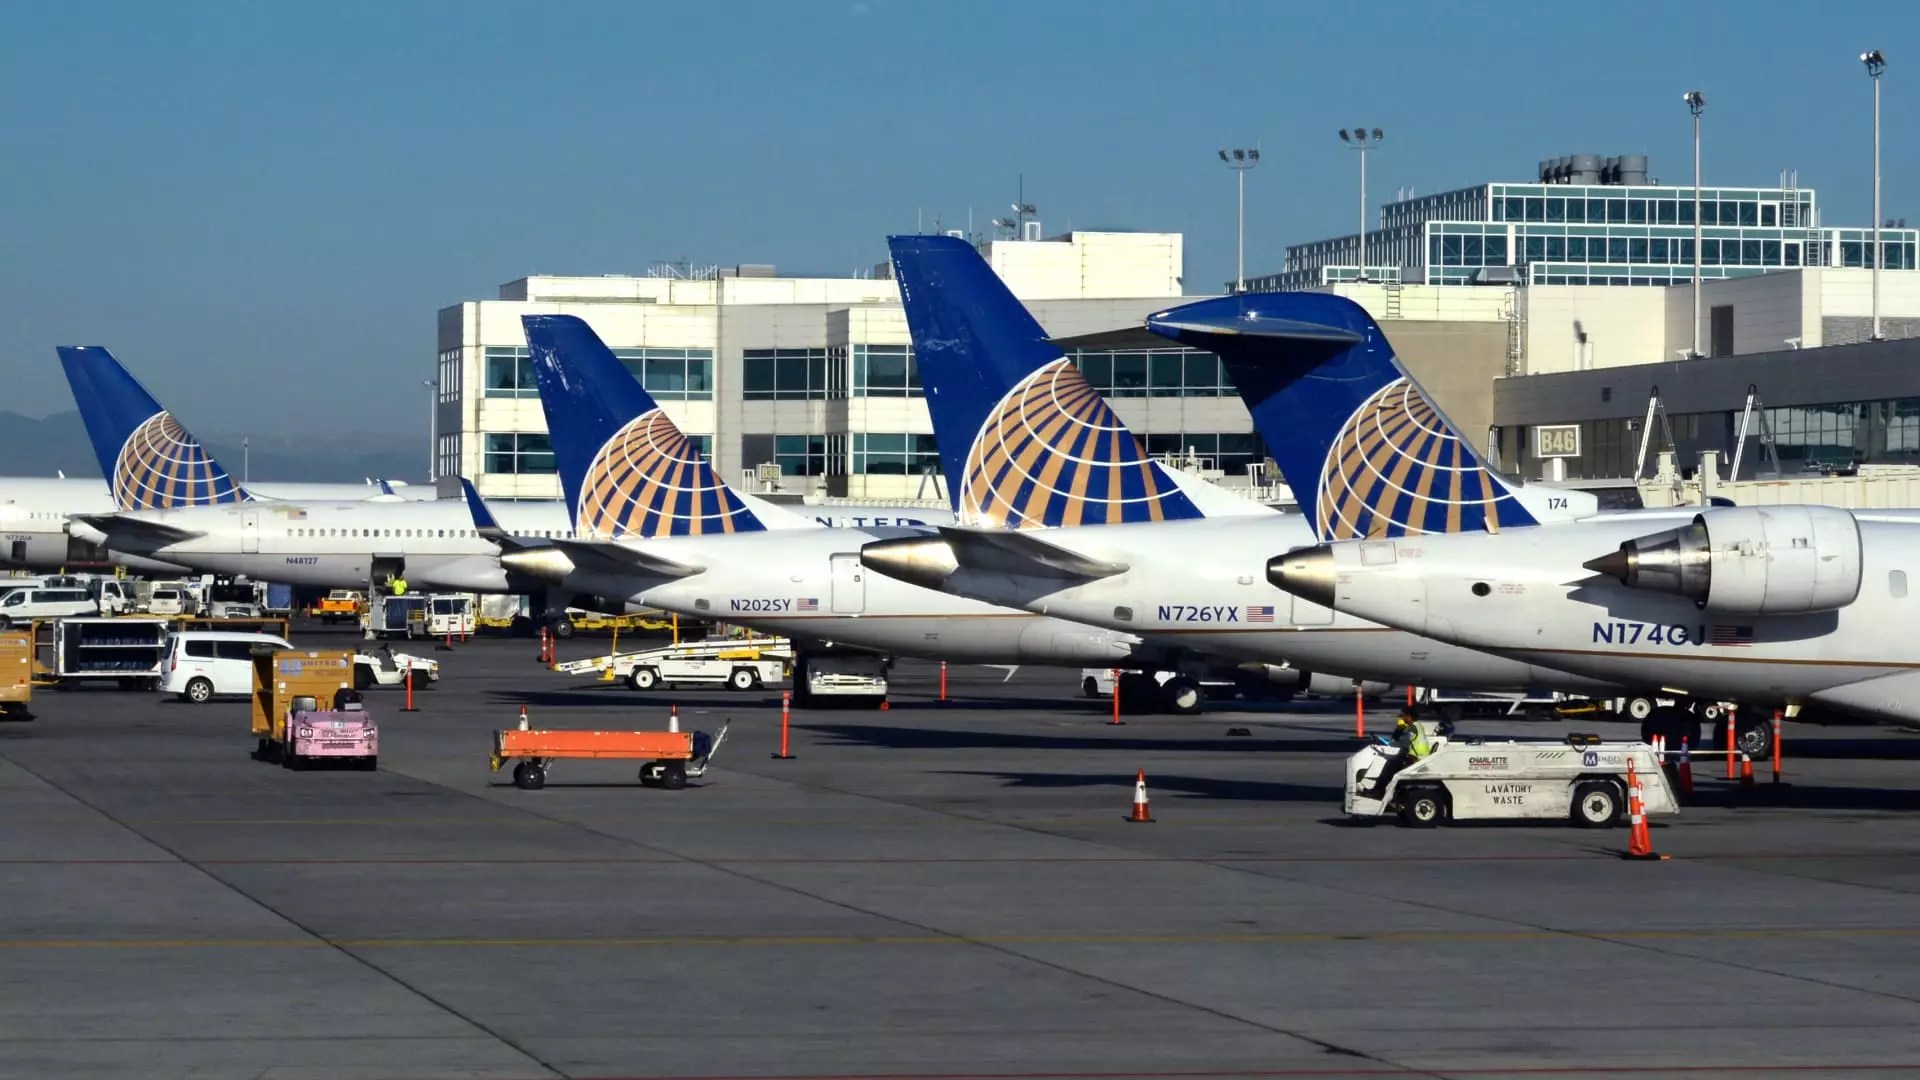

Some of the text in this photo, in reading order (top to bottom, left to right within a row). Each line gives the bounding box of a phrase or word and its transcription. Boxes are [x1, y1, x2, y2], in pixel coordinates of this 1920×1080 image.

[1542, 430, 1574, 452] B46
[1548, 498, 1567, 509] 174
[730, 599, 791, 611] N202SY
[1158, 606, 1239, 622] N726YX
[1592, 622, 1706, 646] N174GJ
[1485, 784, 1532, 793] LAVATORY
[1493, 796, 1523, 804] WASTE
